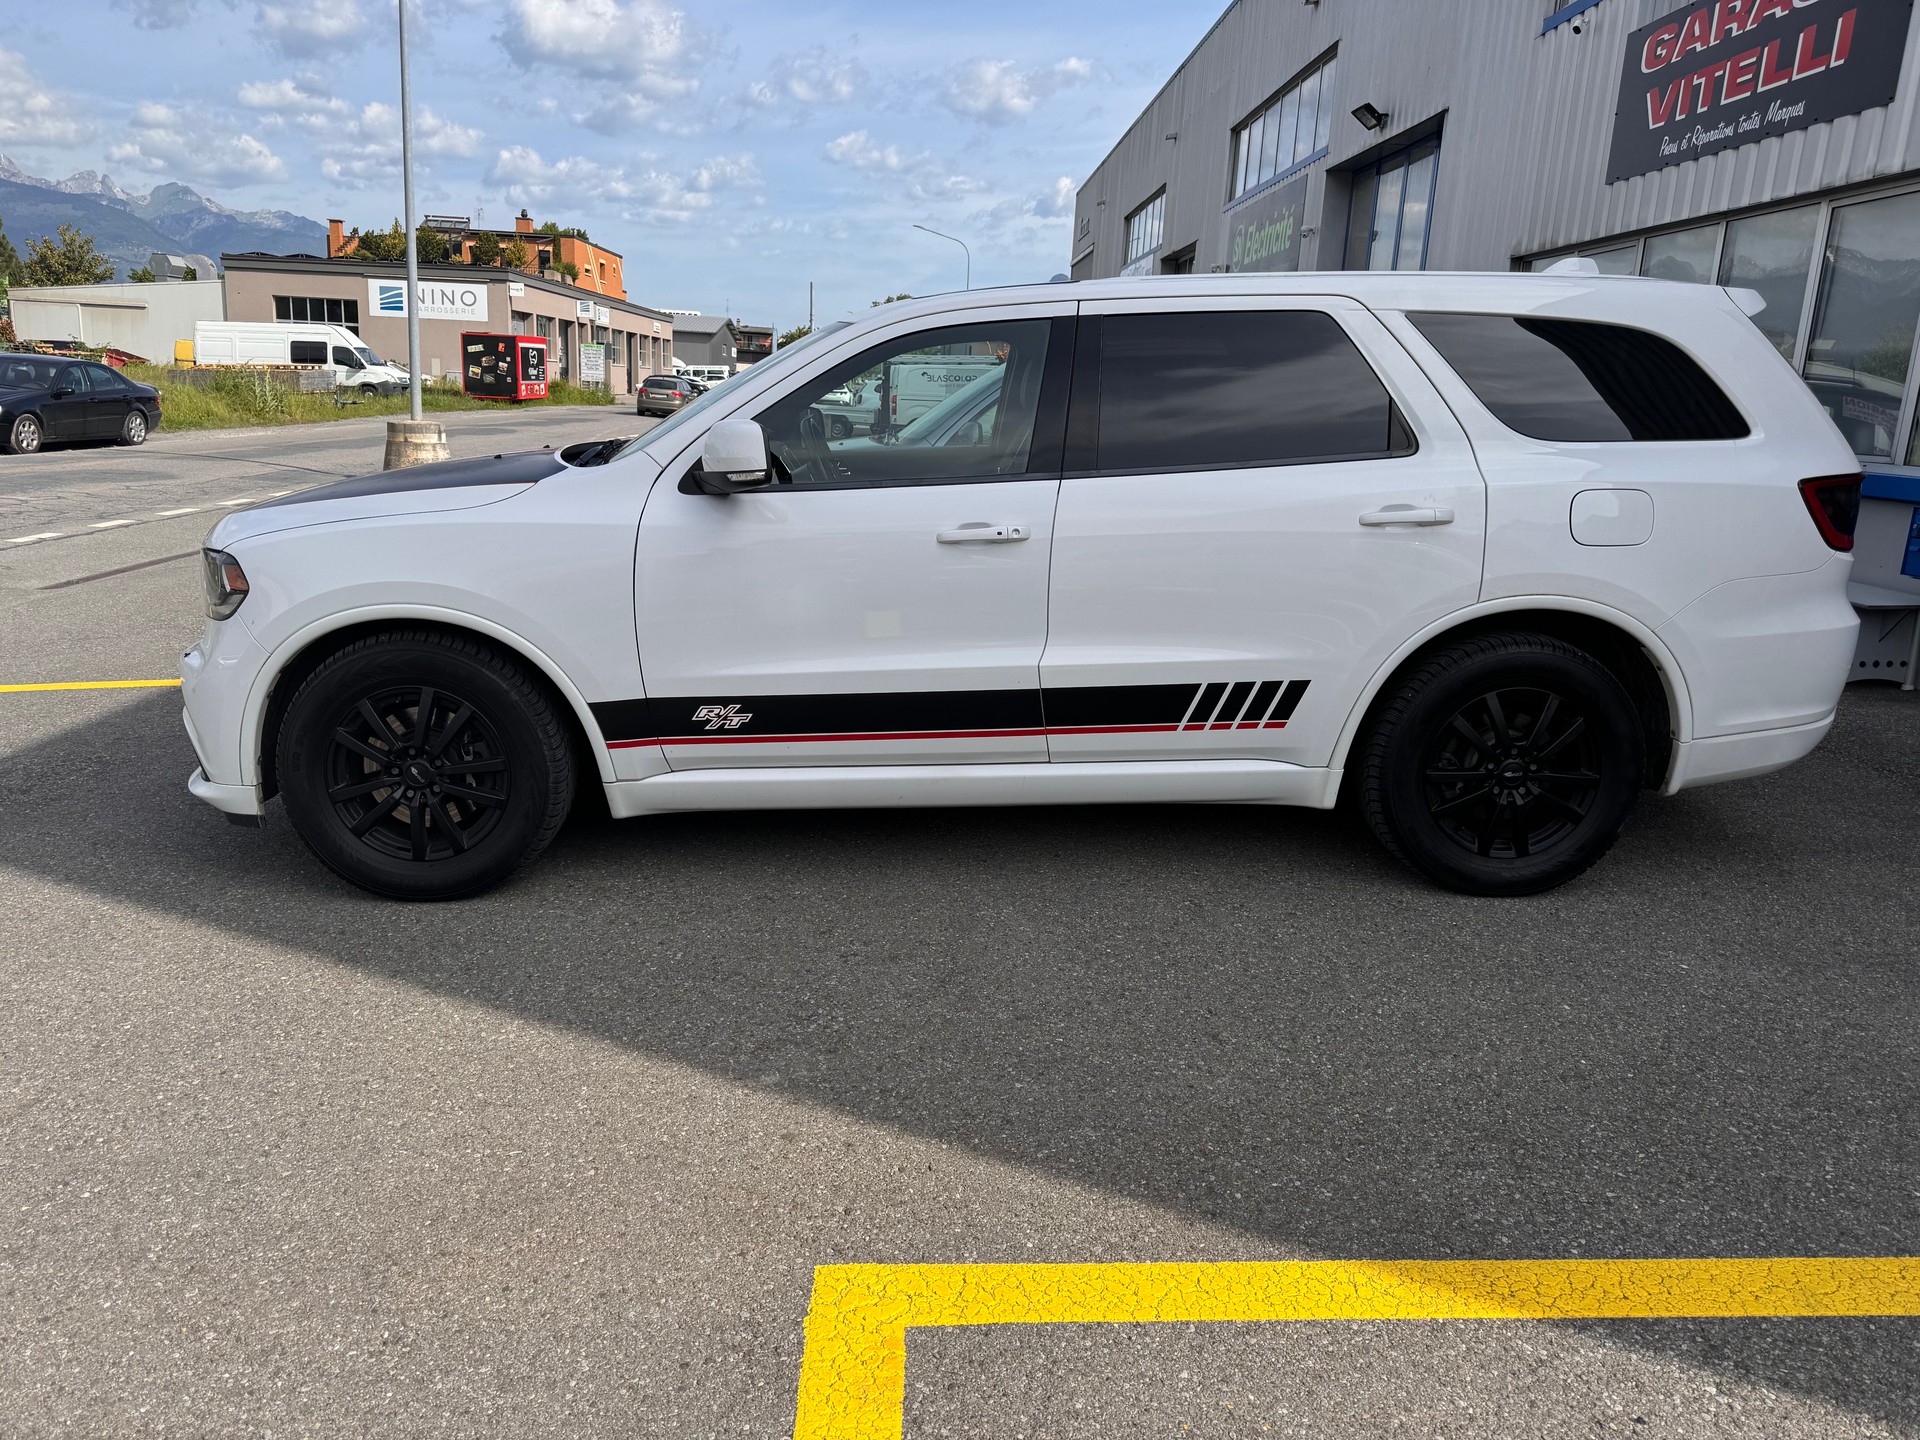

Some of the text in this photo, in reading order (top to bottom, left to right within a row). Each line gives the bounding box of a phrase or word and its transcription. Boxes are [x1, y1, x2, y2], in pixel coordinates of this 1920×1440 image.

[1640, 0, 1819, 73] GARA
[1646, 8, 1857, 130] VITELLI
[1659, 99, 1806, 157] Pneus et Réparations toutes Marques
[417, 288, 477, 307] NINO
[418, 306, 476, 315] ARROSSERIE
[691, 704, 753, 730] R/T
